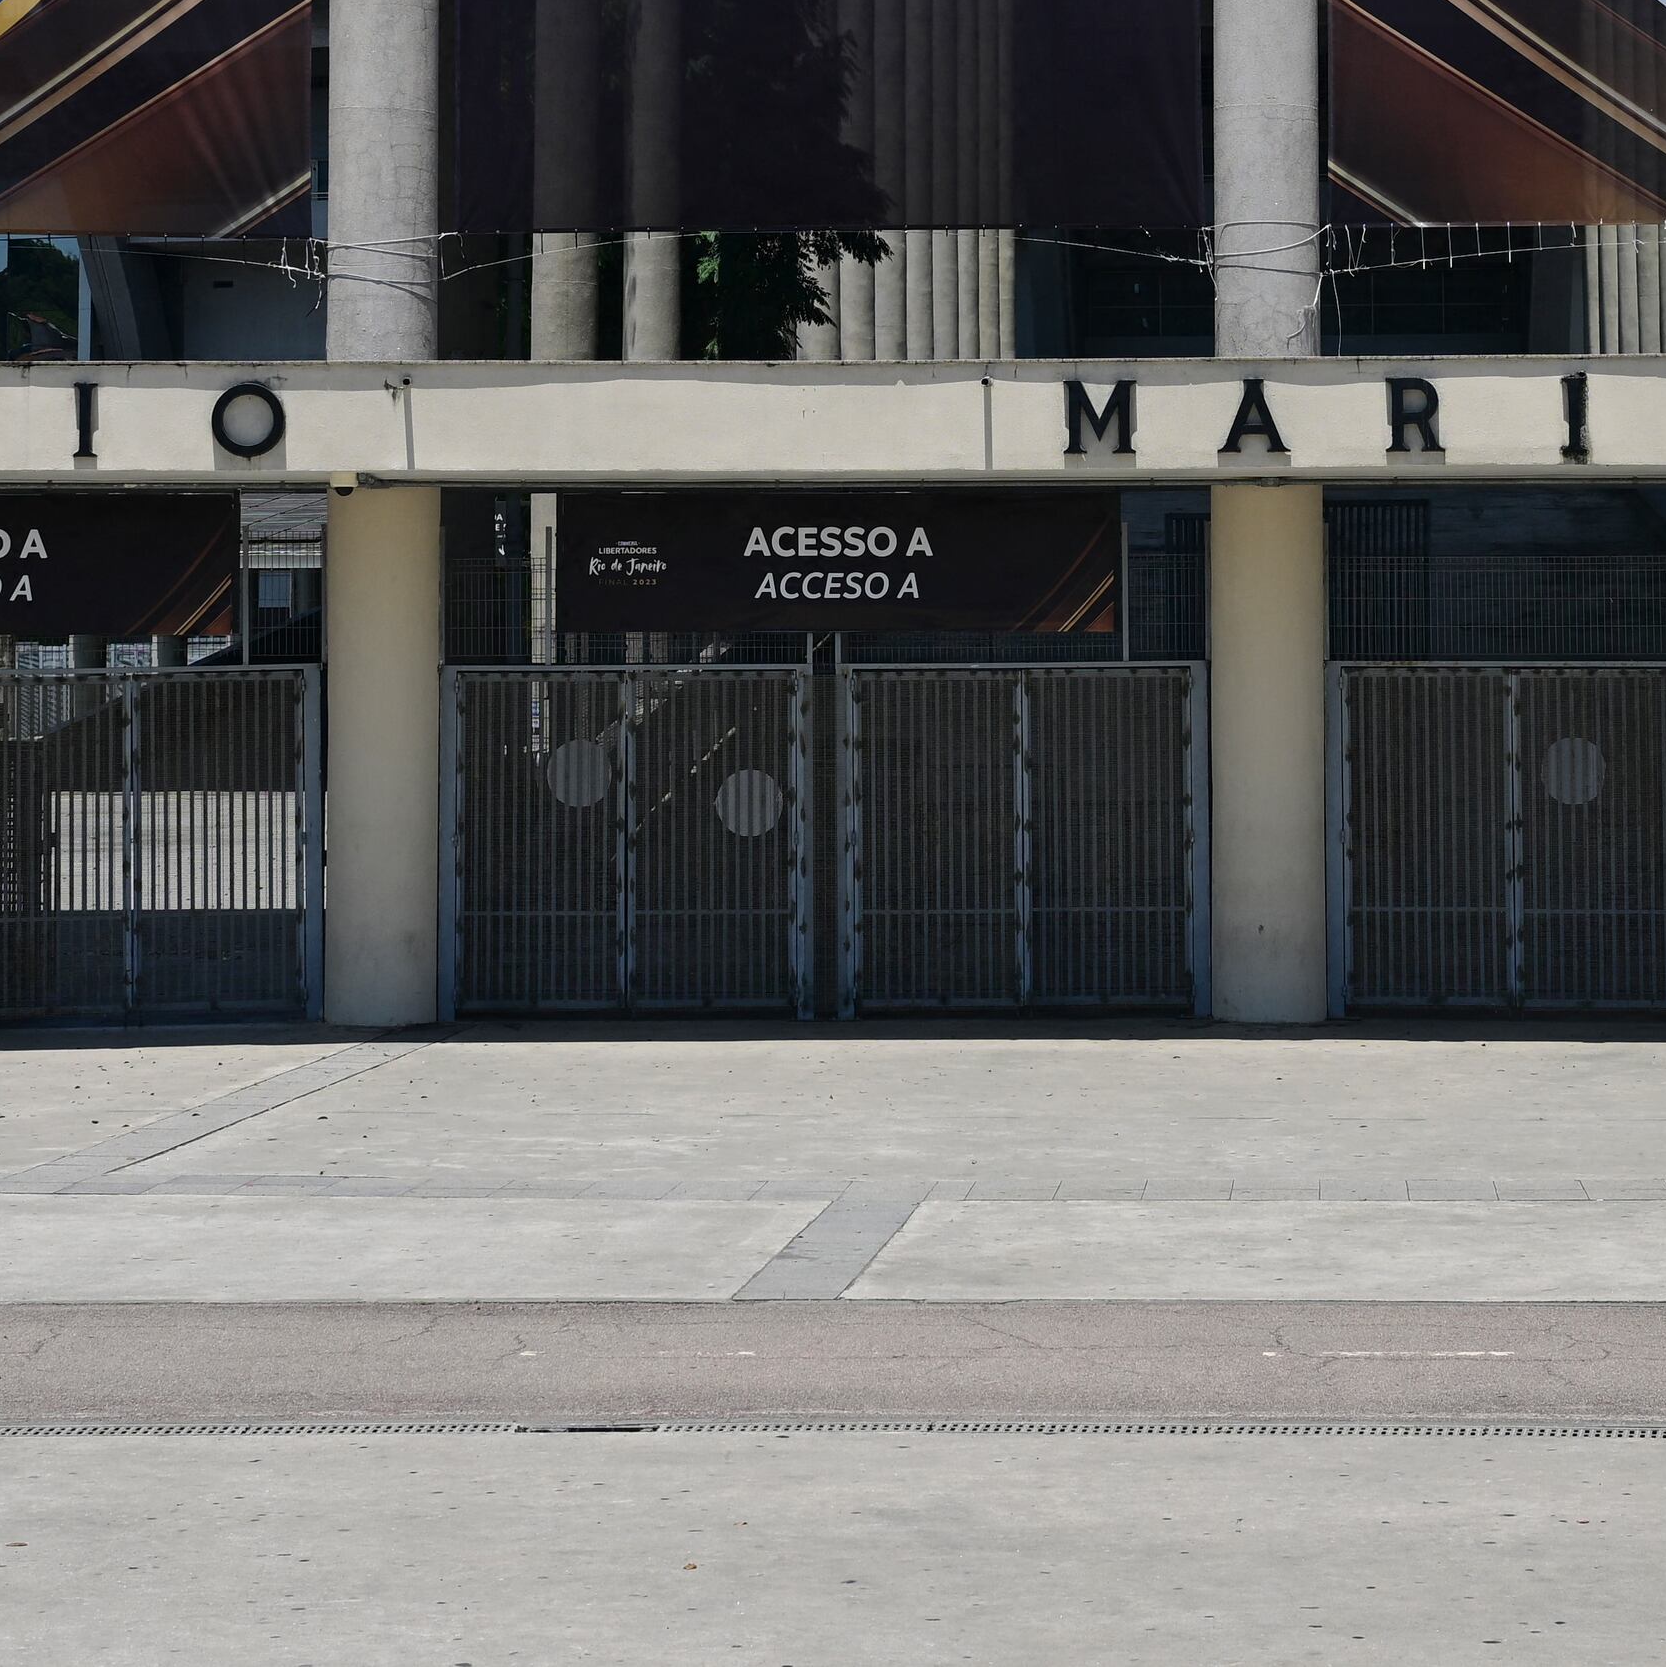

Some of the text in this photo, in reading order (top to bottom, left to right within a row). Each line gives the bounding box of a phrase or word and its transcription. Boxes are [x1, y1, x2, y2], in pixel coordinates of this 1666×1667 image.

[18, 528, 49, 559] A
[742, 526, 934, 558] ACESSO A
[589, 556, 667, 576] Rio de Janeiro
[8, 574, 34, 602] A
[632, 578, 657, 586] 2023
[753, 571, 920, 600] ACCESO A
